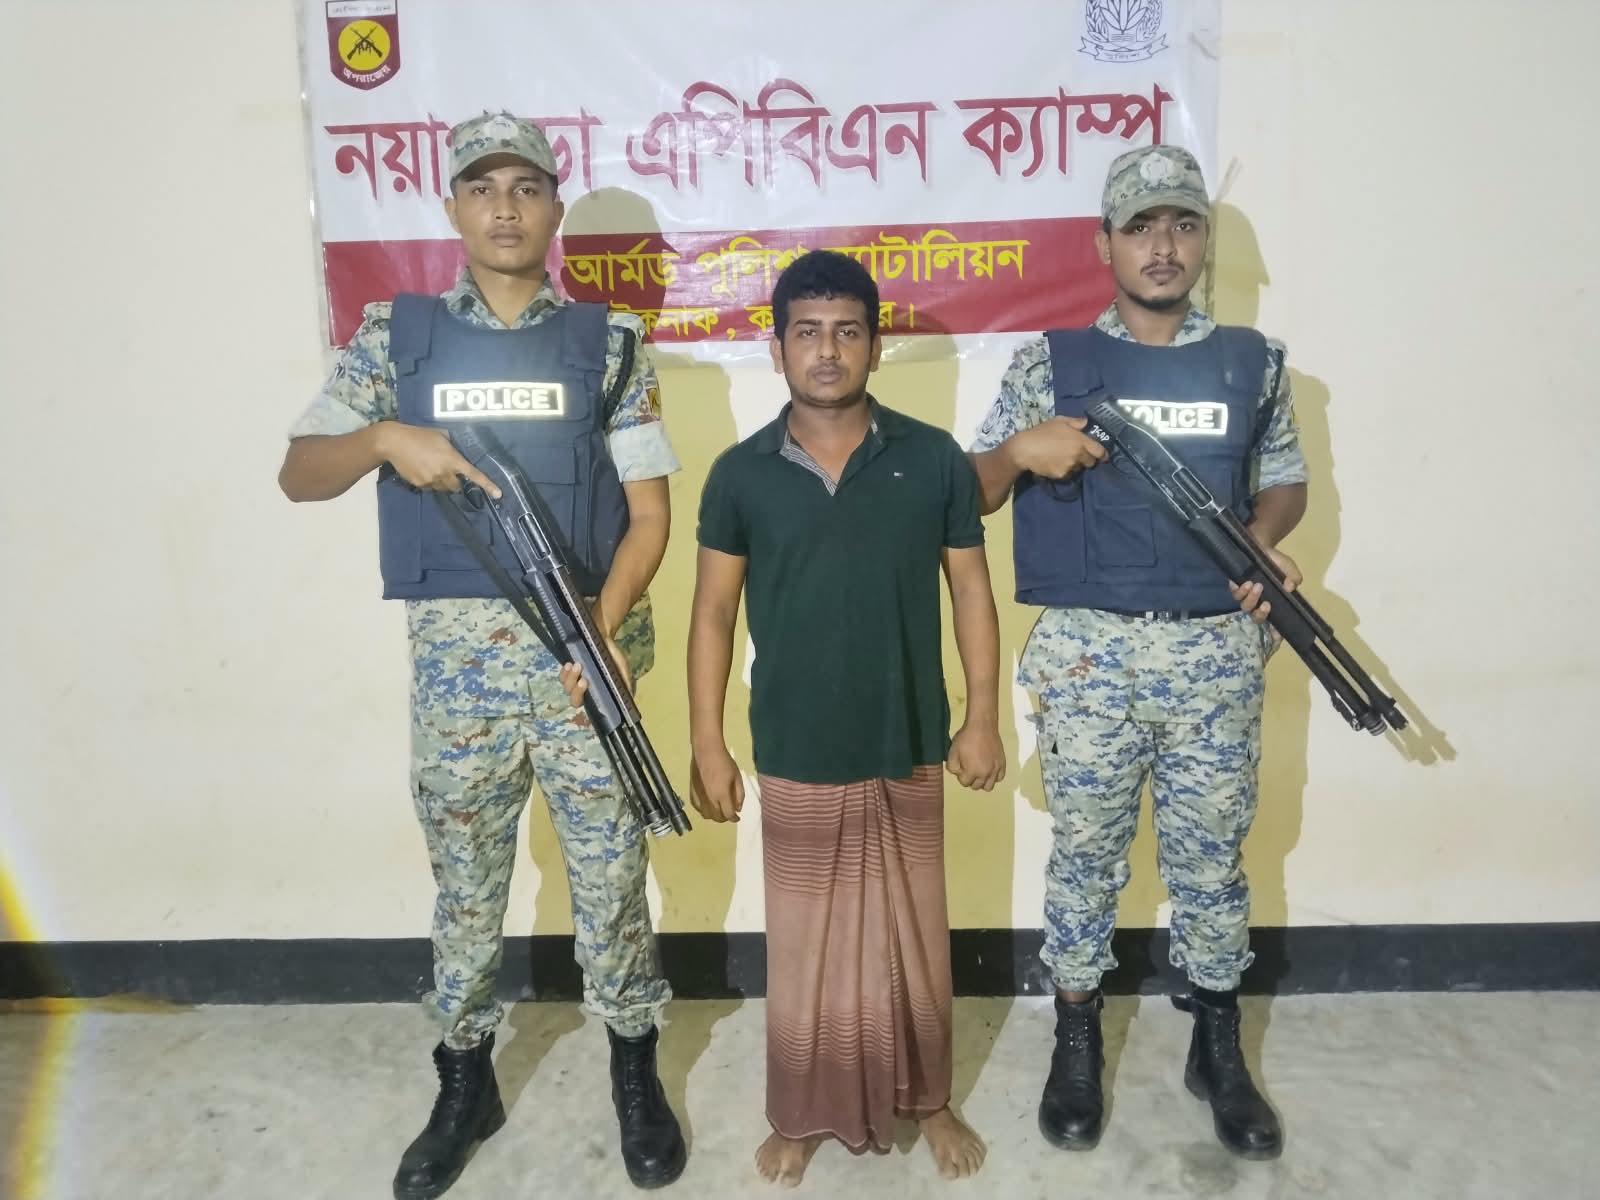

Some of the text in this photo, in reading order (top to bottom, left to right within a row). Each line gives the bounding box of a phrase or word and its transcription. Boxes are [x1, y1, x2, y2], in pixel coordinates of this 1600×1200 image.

[625, 78, 939, 190] এপিবিএন
[446, 387, 551, 412] POLICE
[1125, 404, 1216, 429] OLICE
